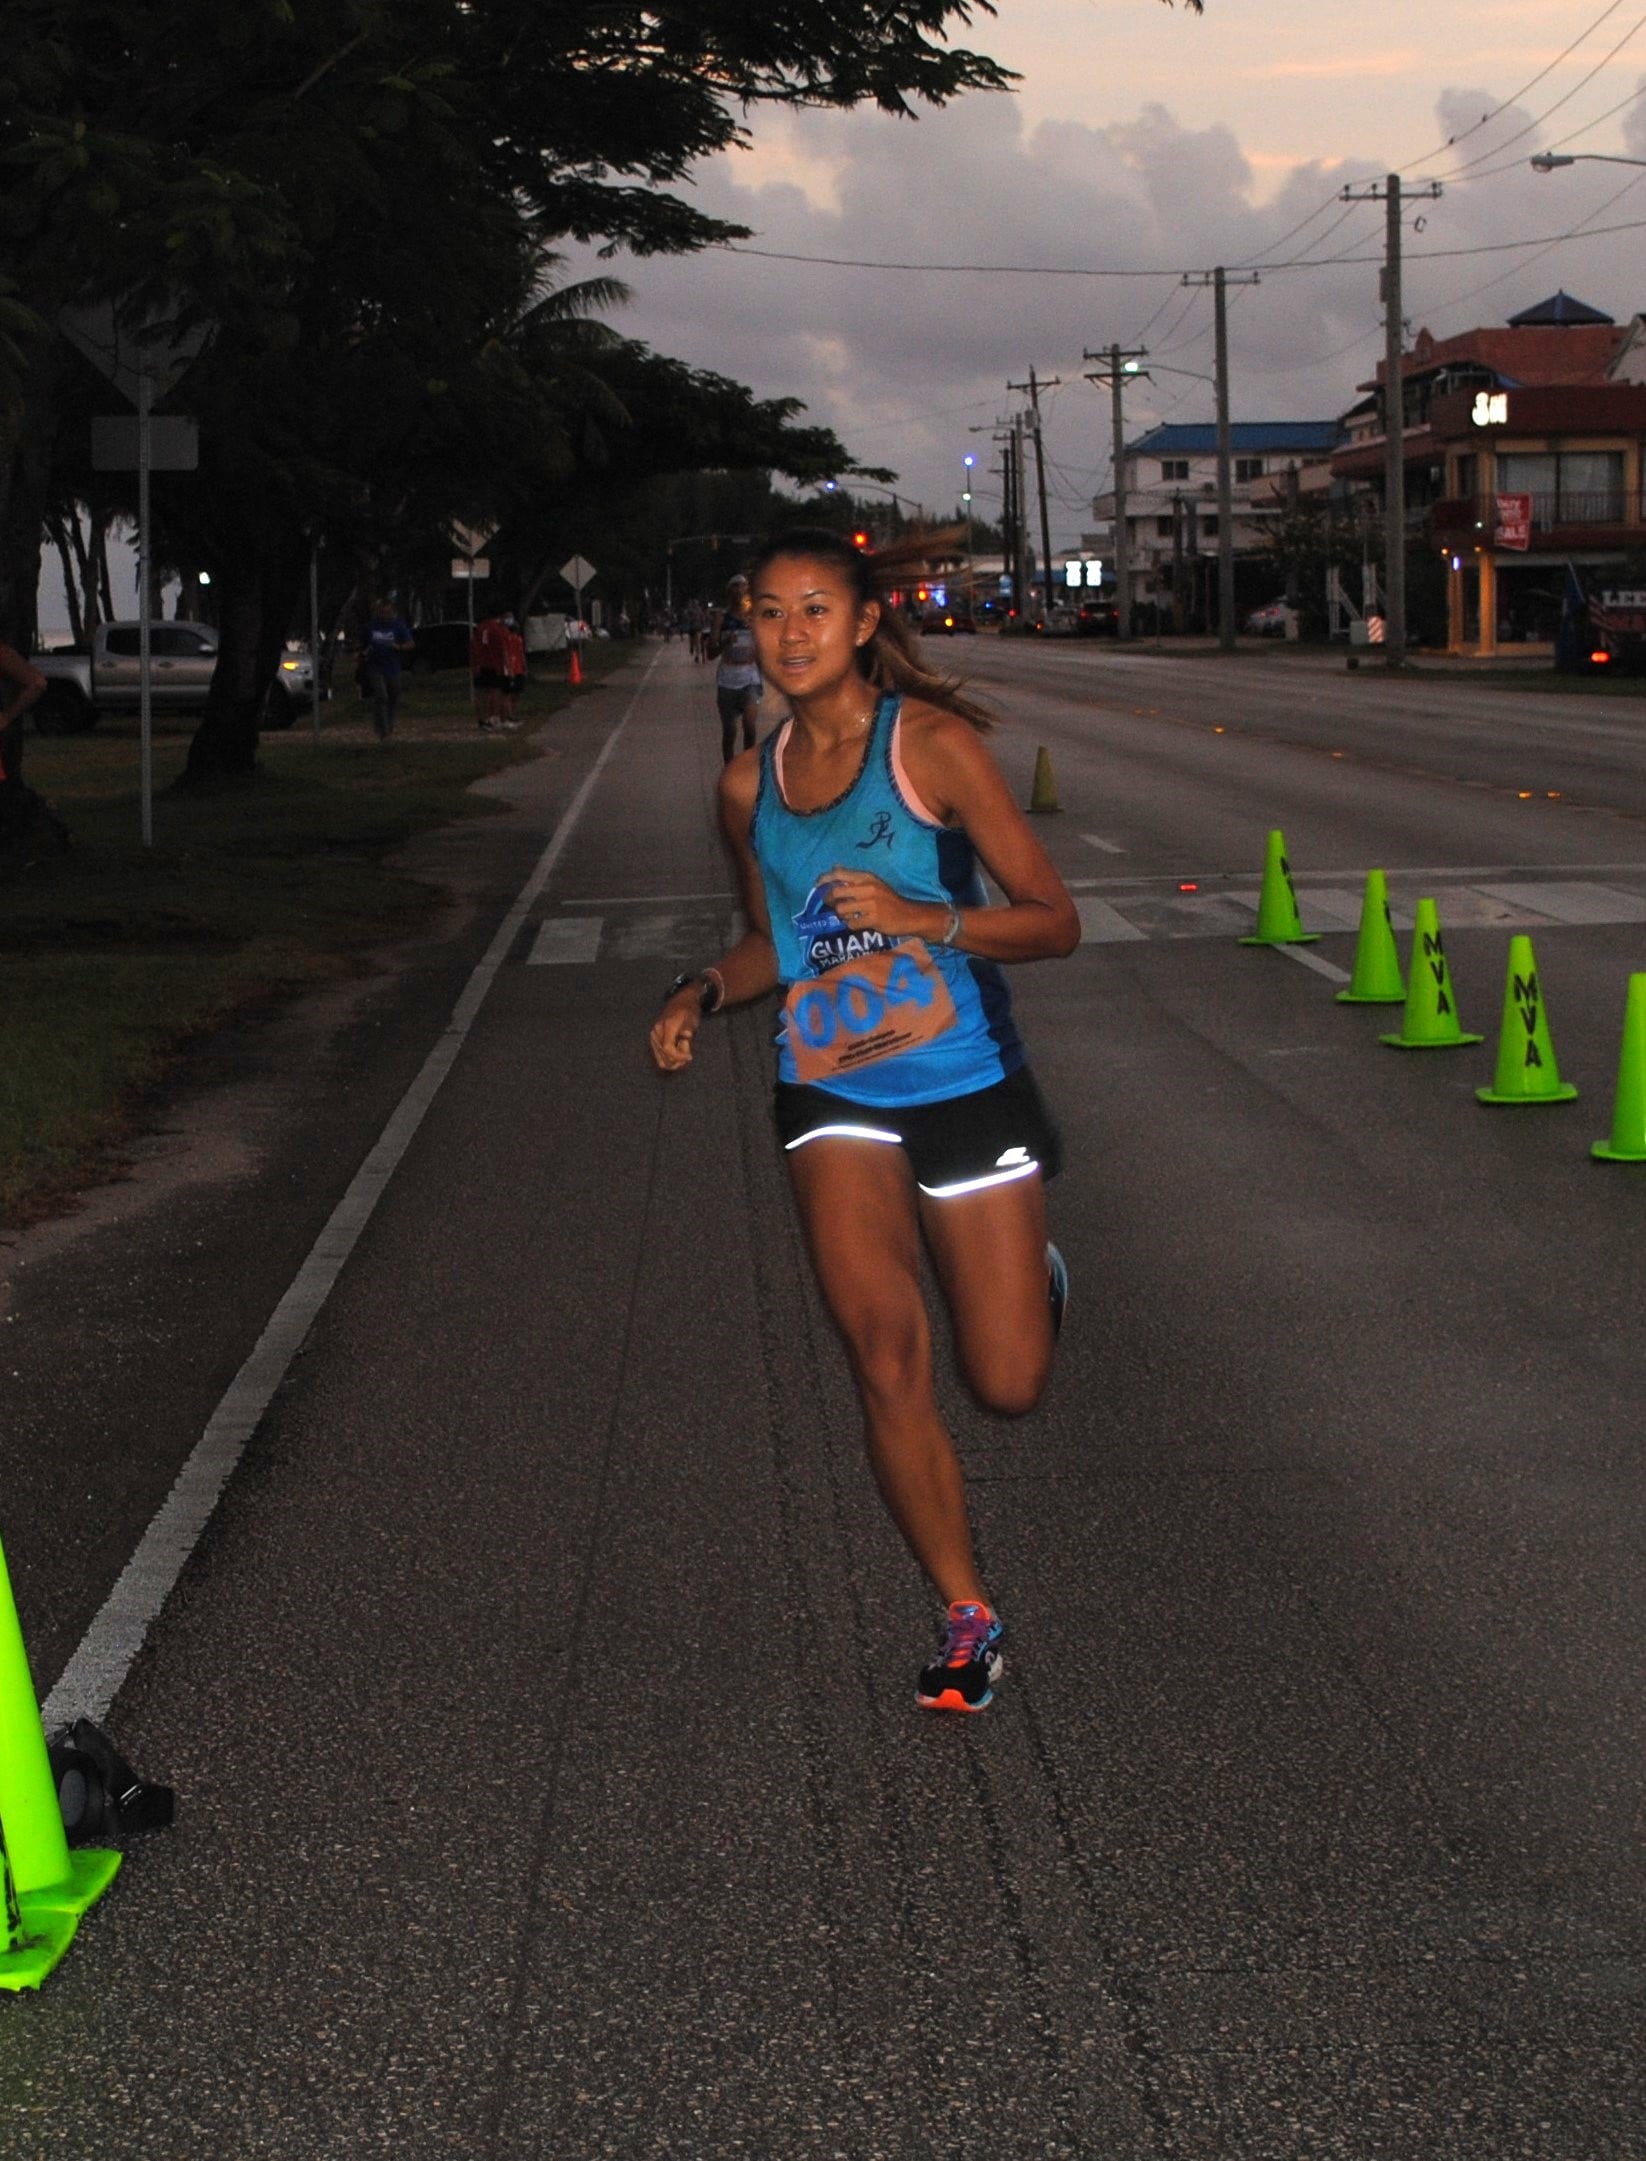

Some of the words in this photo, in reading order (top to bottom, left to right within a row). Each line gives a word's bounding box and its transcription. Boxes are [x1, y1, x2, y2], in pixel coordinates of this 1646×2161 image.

[811, 931, 884, 959] GUAM
[1423, 930, 1451, 1016] MVA
[1513, 972, 1543, 1068] MVA
